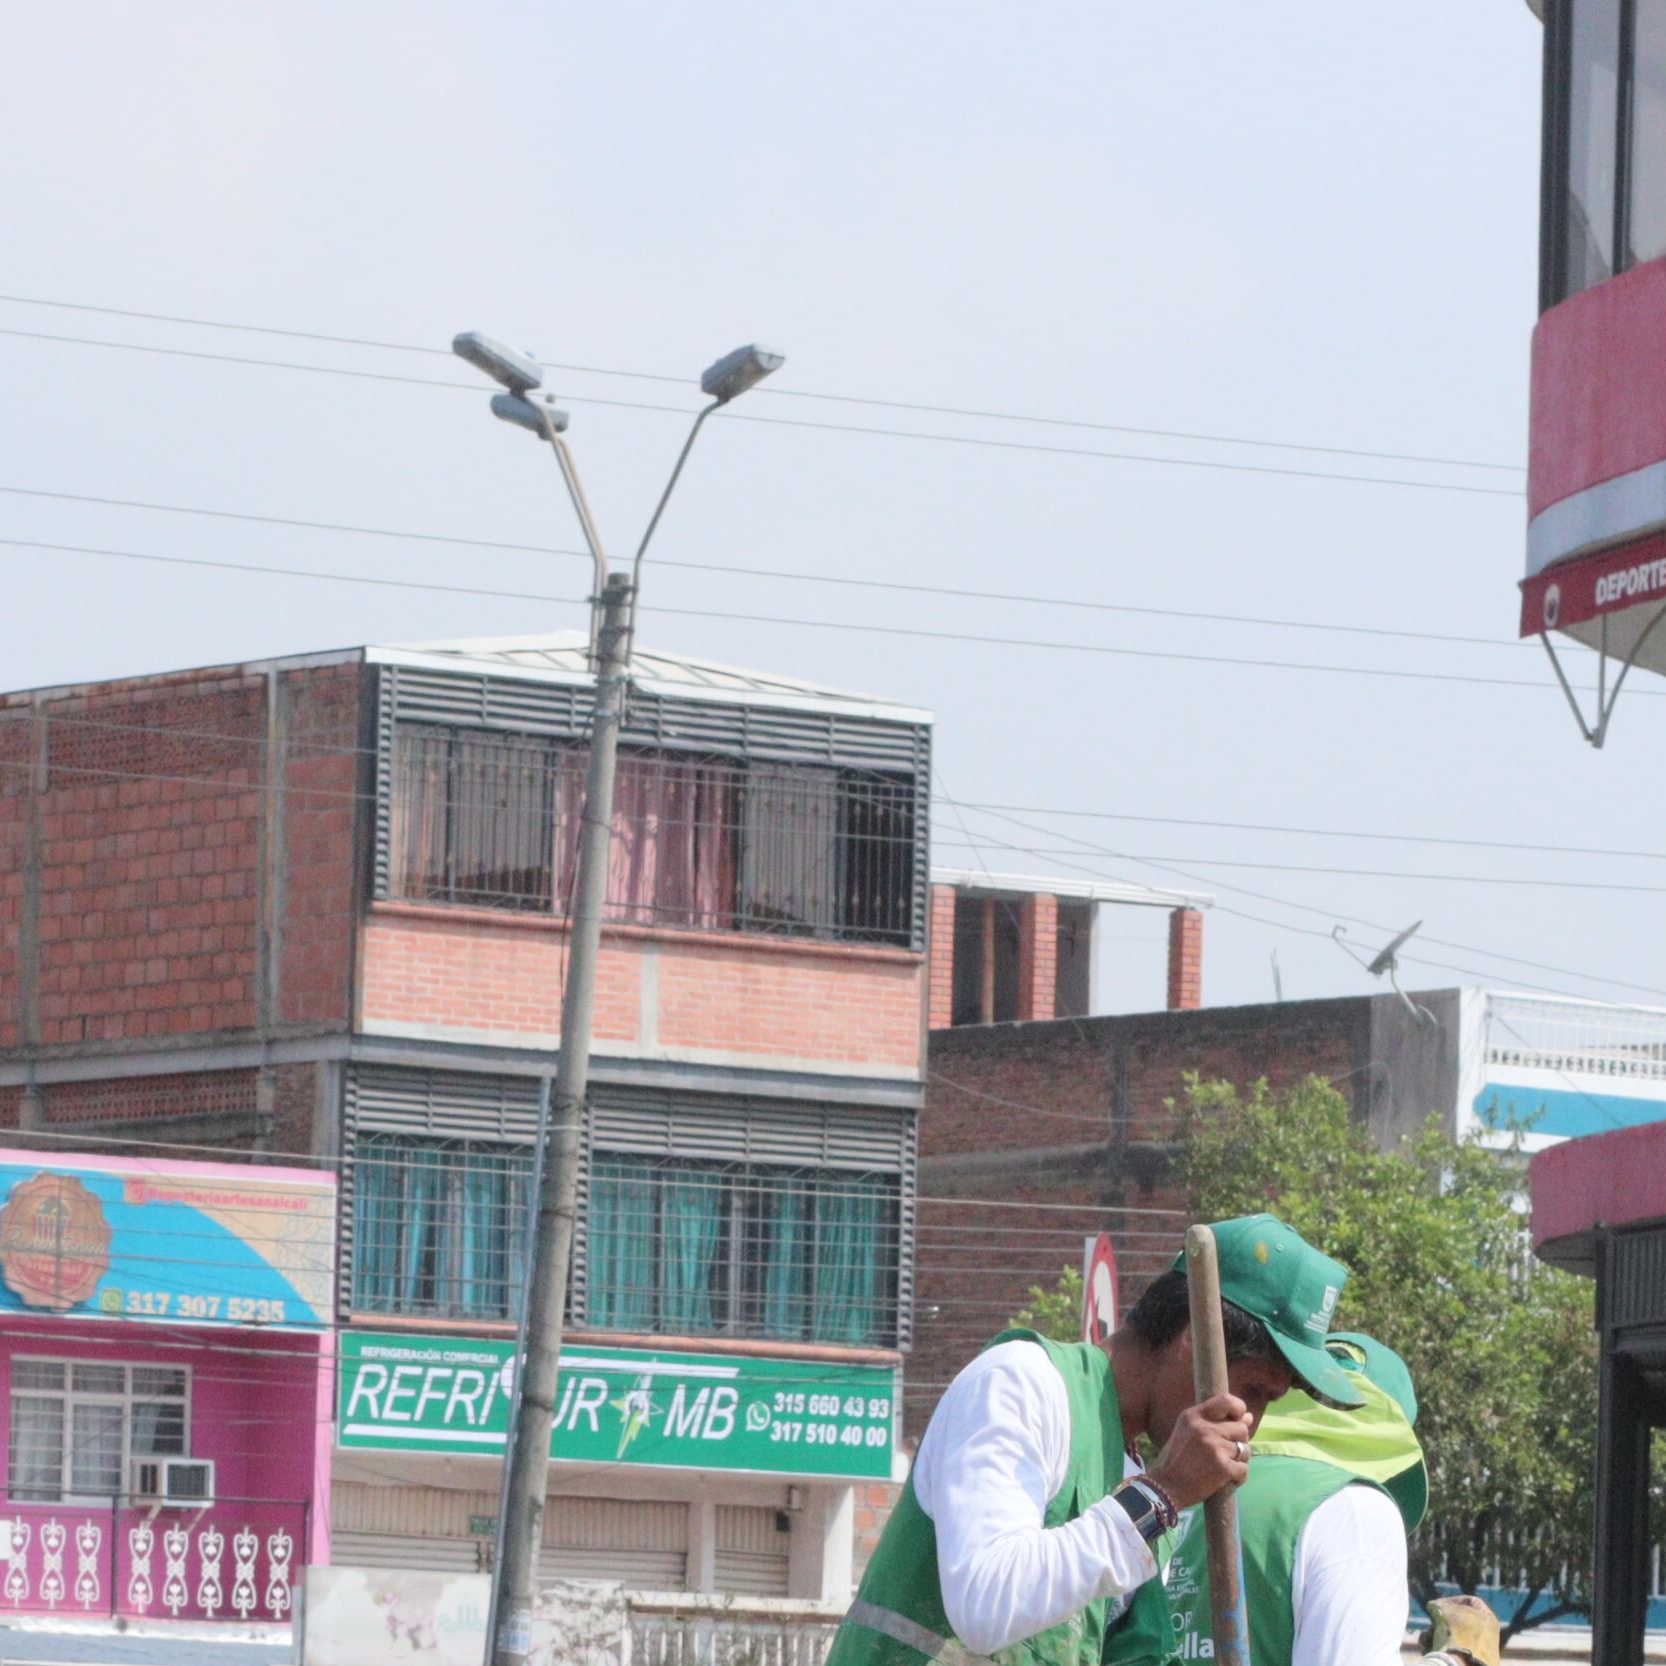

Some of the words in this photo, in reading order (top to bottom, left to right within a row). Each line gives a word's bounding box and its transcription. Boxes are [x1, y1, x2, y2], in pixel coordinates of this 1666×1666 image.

[126, 1291, 170, 1315] 317
[177, 1294, 221, 1318] 307
[227, 1296, 285, 1322] 5235
[663, 1384, 739, 1440] MB
[773, 1391, 805, 1414] 315
[808, 1393, 840, 1417] 660
[843, 1396, 865, 1418] 43
[868, 1398, 890, 1420] 93
[770, 1420, 802, 1442] 317
[805, 1422, 837, 1445] 510
[840, 1424, 863, 1446] 40
[865, 1425, 887, 1447] 00
